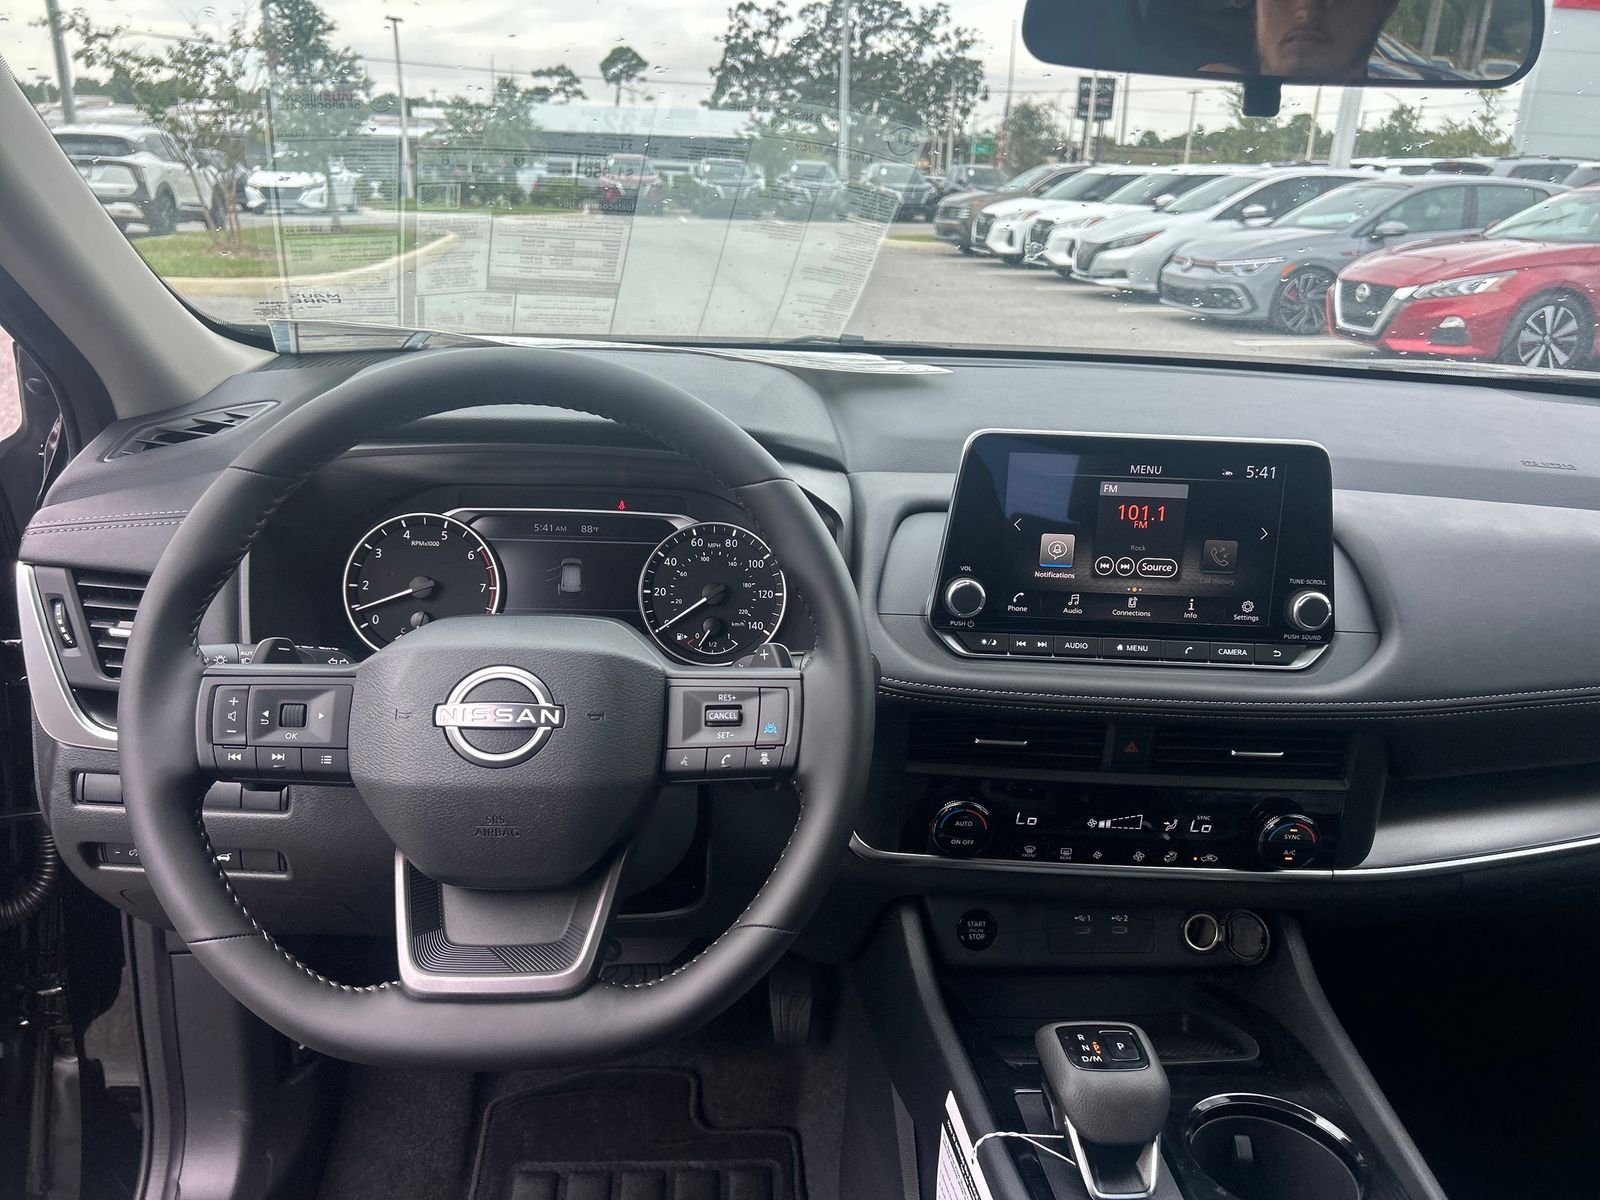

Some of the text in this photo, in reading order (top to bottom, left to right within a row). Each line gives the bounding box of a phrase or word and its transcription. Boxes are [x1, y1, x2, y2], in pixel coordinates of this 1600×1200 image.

[1130, 465, 1162, 475] MENU
[1245, 465, 1277, 479] 5:41
[1103, 484, 1118, 493] FM
[1118, 504, 1166, 522] 101.1
[534, 523, 553, 532] 5:41
[1133, 521, 1148, 529] FM
[403, 530, 411, 539] 4
[441, 531, 448, 541] 5
[690, 538, 704, 547] 60
[725, 538, 738, 548] 80
[375, 549, 382, 559] 3
[467, 551, 475, 560] 6
[664, 557, 677, 567] 40
[749, 560, 764, 569] 100
[1142, 562, 1173, 572] Source
[1034, 571, 1075, 580] Notifications
[362, 581, 369, 590] 2
[480, 584, 487, 593] 7
[654, 587, 667, 597] 20
[758, 590, 774, 599] 120
[1007, 605, 1028, 613] Phone
[1063, 607, 1083, 615] Audio
[1112, 609, 1151, 618] Connections
[1184, 611, 1198, 619] Info
[1233, 613, 1259, 622] Settings
[372, 615, 380, 625] 0
[748, 621, 764, 630] 140
[1064, 642, 1089, 650] AUDIO
[1126, 644, 1149, 652] MENU
[1217, 648, 1248, 656] CAMERA
[718, 694, 737, 702] RES+
[438, 706, 560, 725] NISSAN
[708, 711, 738, 720] CANCEL
[285, 732, 298, 740] OK
[485, 815, 505, 825] SRS
[1015, 812, 1038, 827] Lo
[1190, 819, 1212, 833] Lo
[474, 828, 520, 838] AIRBAG
[1284, 833, 1301, 841] SYNC
[967, 920, 987, 928] START
[968, 933, 986, 941] STOP
[1077, 1033, 1085, 1041] R
[1081, 1044, 1091, 1052] N
[1116, 1042, 1125, 1050] P
[1081, 1055, 1103, 1063] D/M
